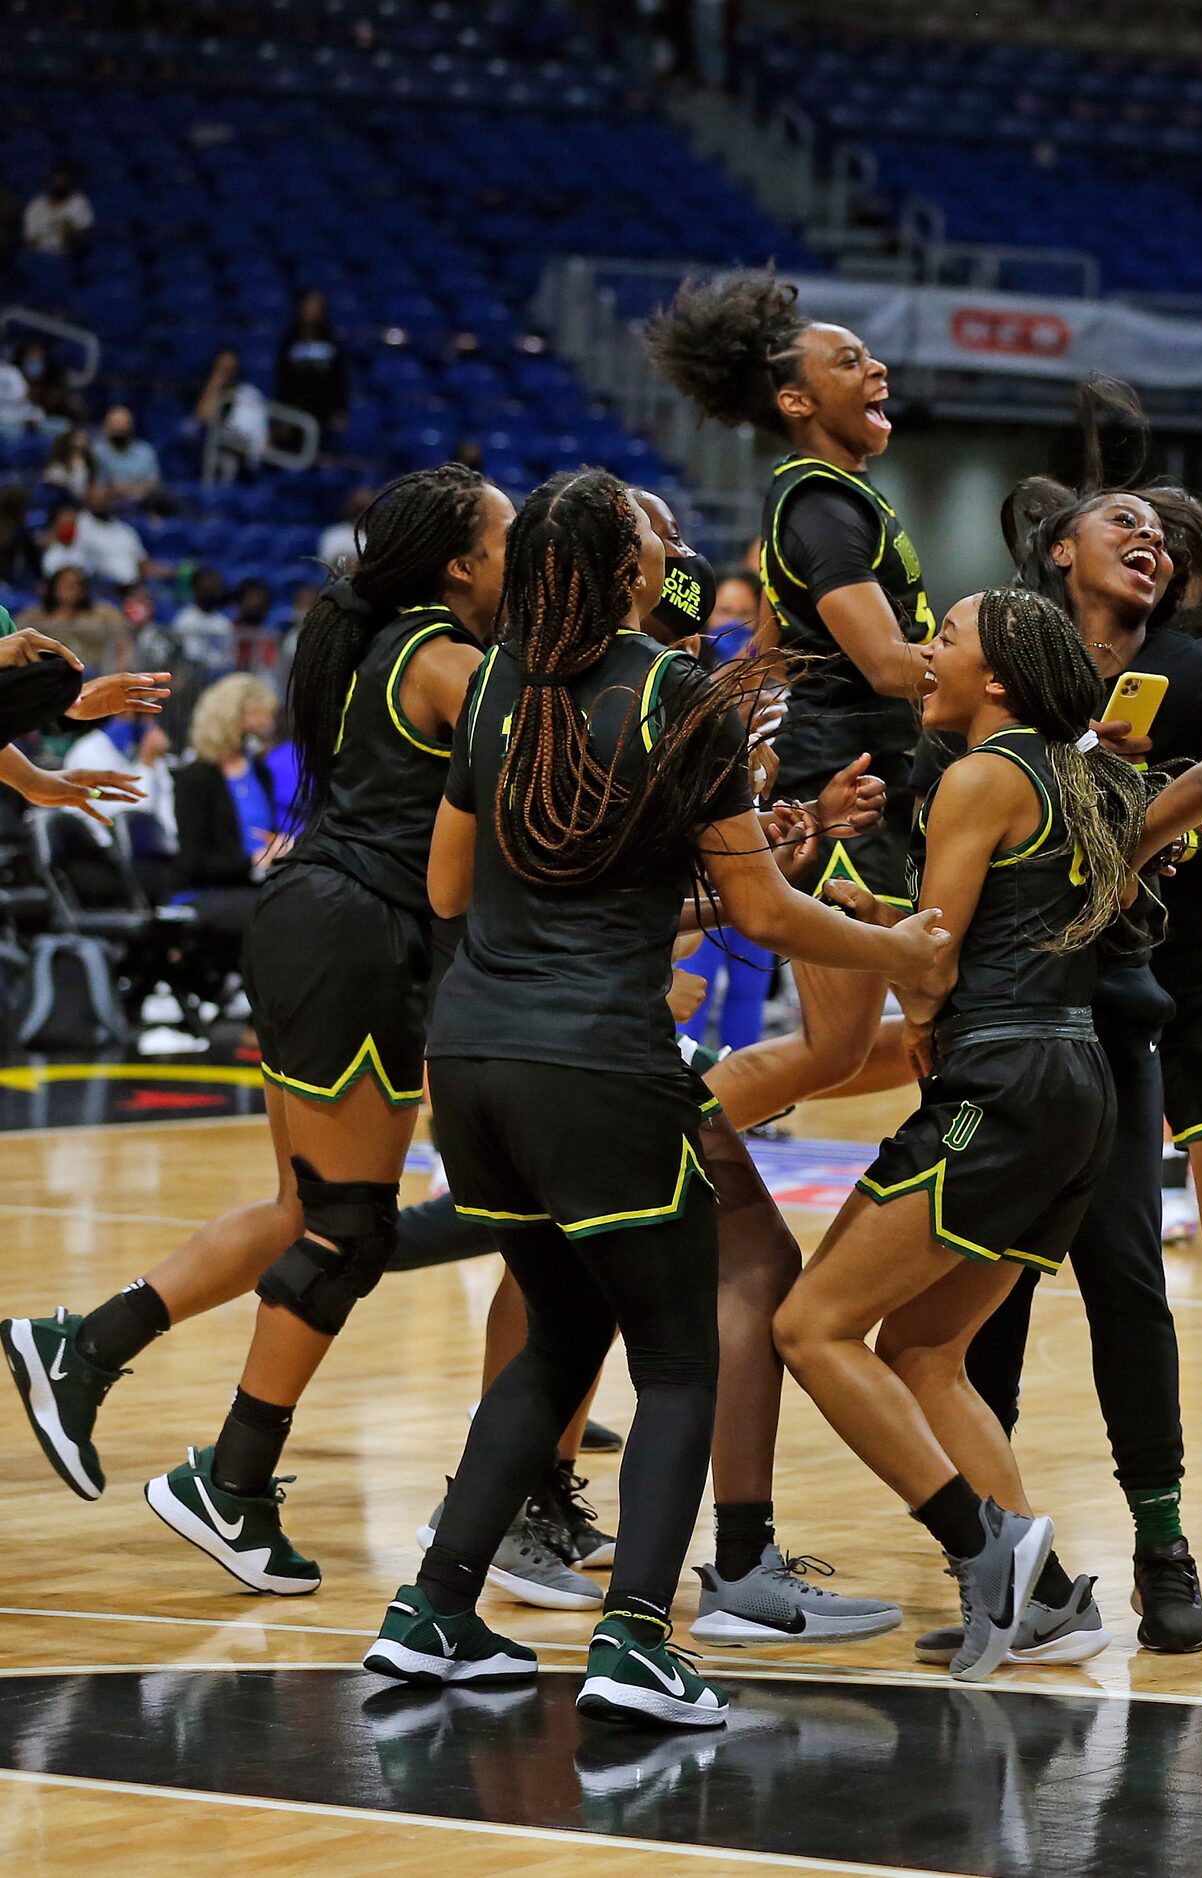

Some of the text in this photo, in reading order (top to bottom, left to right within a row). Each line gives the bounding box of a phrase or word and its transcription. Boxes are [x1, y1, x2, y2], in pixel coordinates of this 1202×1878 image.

[664, 577, 701, 607] OUR
[671, 567, 701, 595] IT'S
[661, 586, 701, 621] TIME.
[941, 1100, 984, 1151] D
